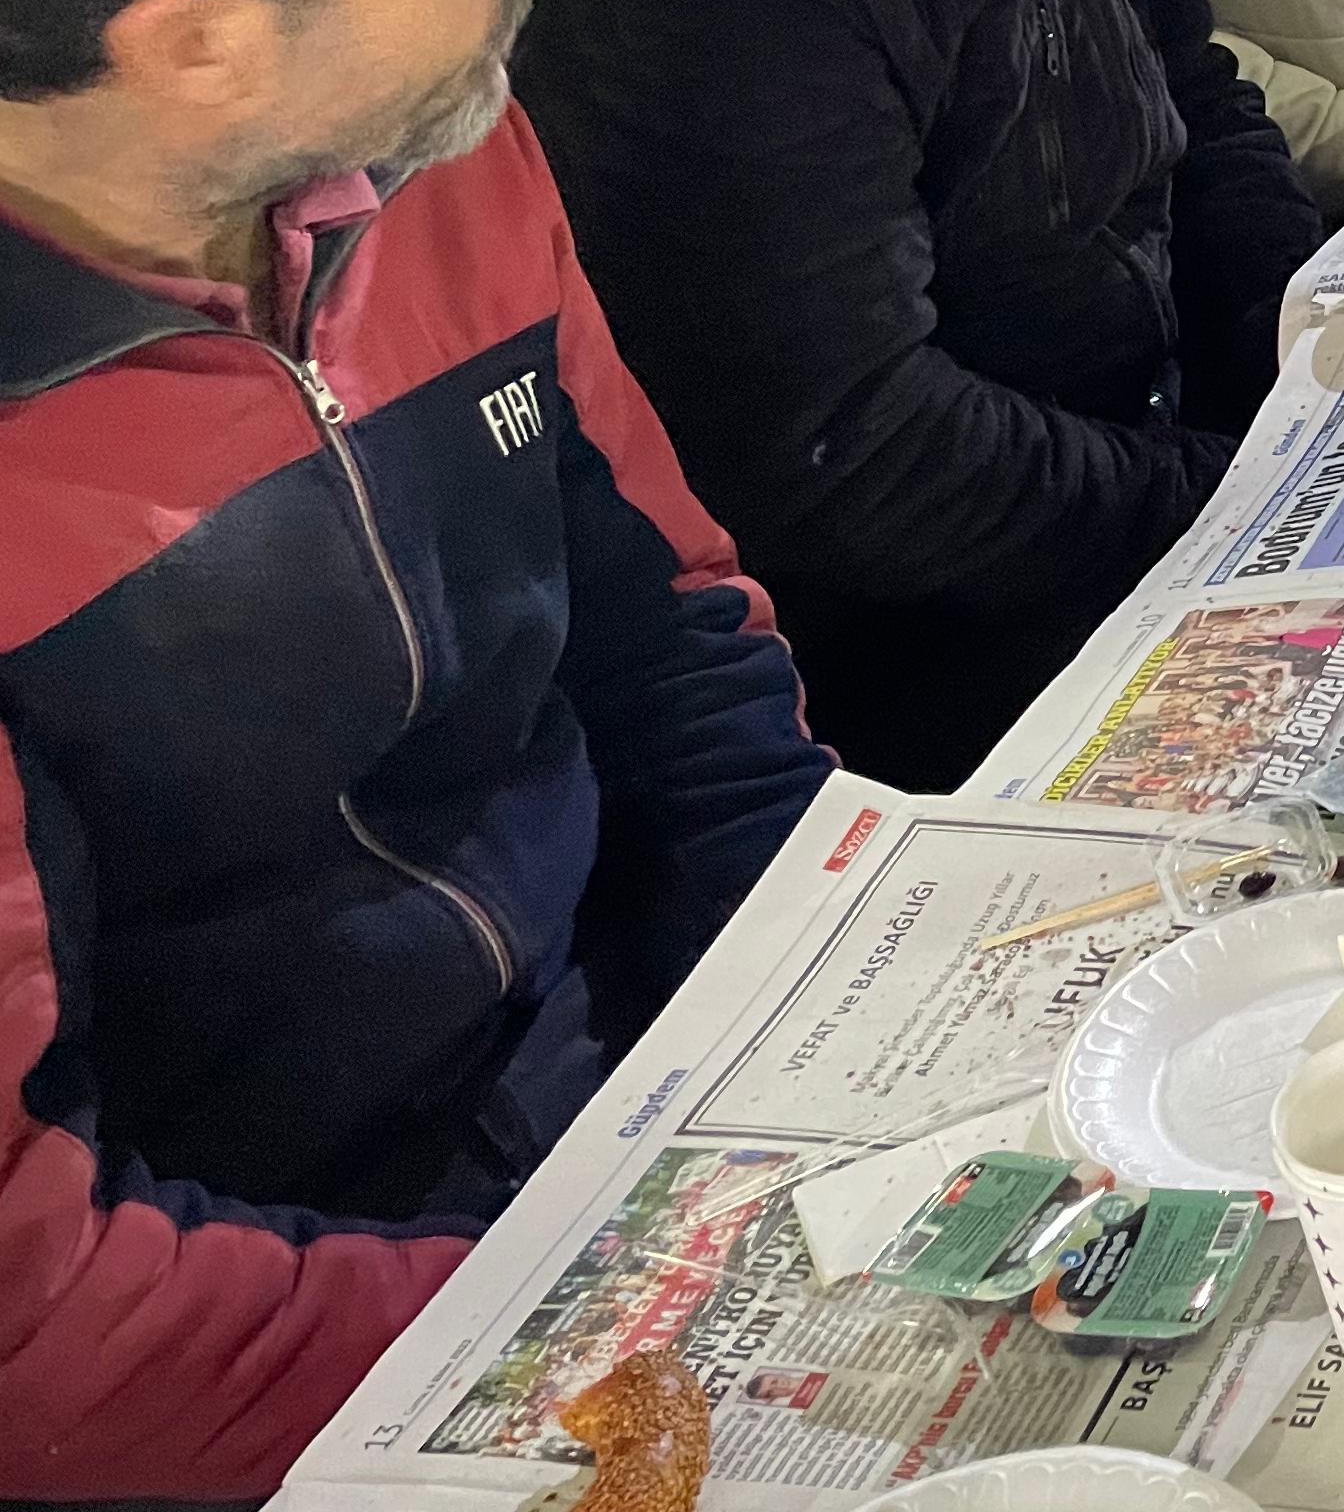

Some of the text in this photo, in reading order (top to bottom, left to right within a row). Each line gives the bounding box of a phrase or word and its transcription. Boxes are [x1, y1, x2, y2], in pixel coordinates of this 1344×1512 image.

[479, 371, 543, 456] FIAT
[780, 880, 940, 1073] VEFAT ve BAŞSAĞLIĞI
[914, 1030, 959, 1077] Ahmet
[617, 1067, 688, 1139] Gündem
[1289, 1379, 1332, 1430] ELİF
[364, 1423, 403, 1451] 13
